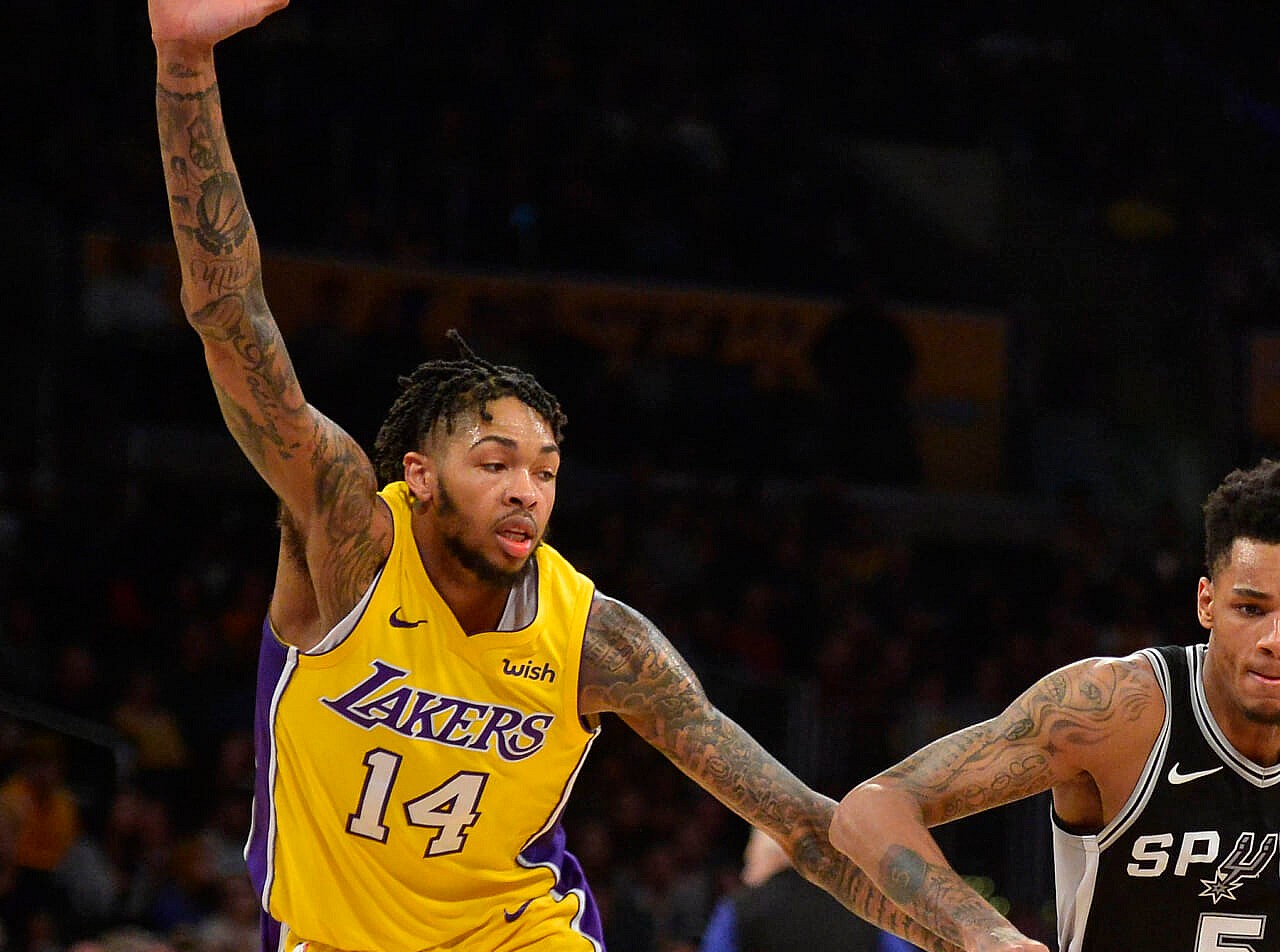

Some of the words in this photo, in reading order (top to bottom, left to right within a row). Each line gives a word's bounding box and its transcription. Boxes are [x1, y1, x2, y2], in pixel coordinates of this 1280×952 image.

[318, 658, 556, 762] LAKERS
[502, 658, 556, 684] wish
[345, 747, 490, 858] 14
